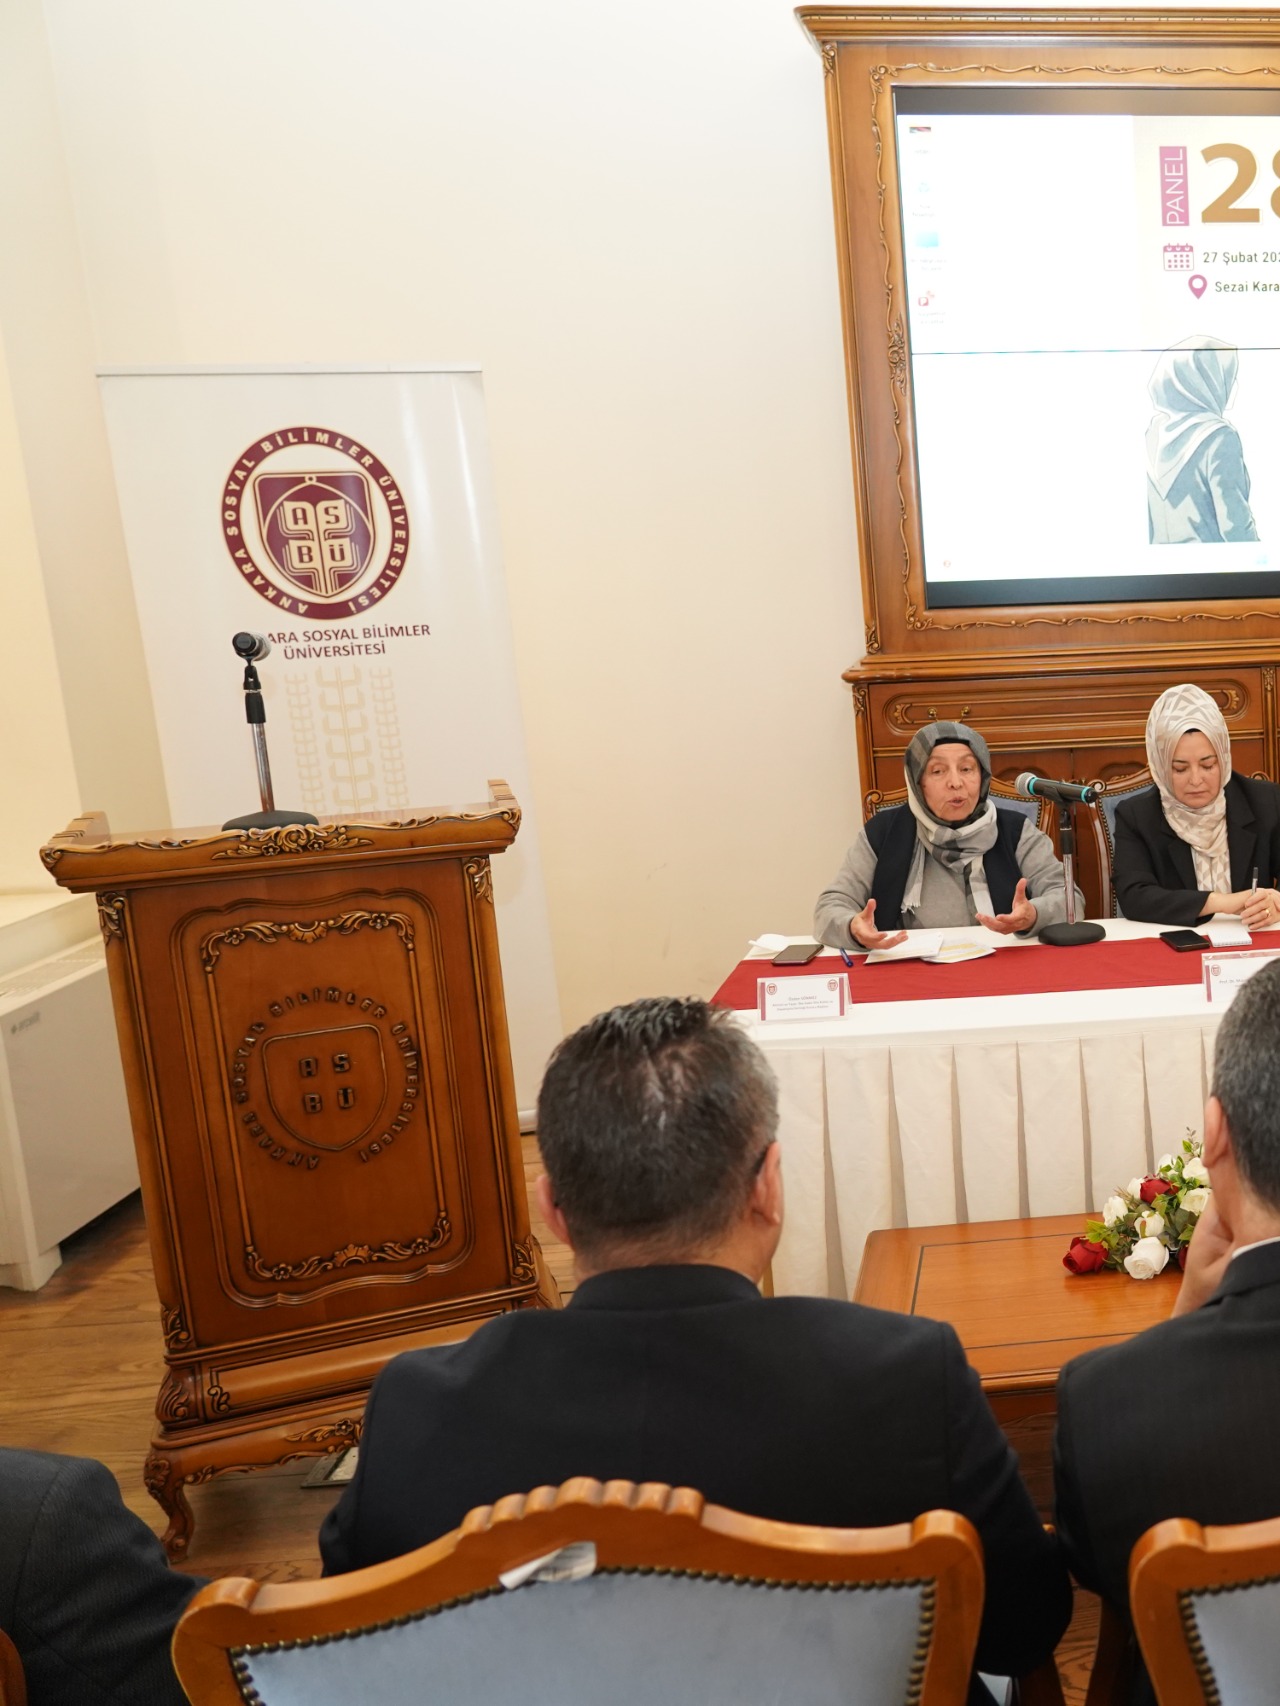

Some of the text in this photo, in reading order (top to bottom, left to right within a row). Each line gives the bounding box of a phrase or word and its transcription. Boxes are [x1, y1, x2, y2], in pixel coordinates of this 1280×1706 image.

[1165, 147, 1184, 225] PANEL
[1203, 251, 1218, 263] 27
[1222, 251, 1258, 266] Şubat
[1214, 280, 1249, 293] Sezai
[224, 427, 406, 614] ANKARA SOSYAL BİLİMLER ÜNİVERSİTESİ
[268, 623, 431, 645] ARA SOSYAL BİLİMLER
[283, 640, 387, 661] ÜNİVERSİTESİ
